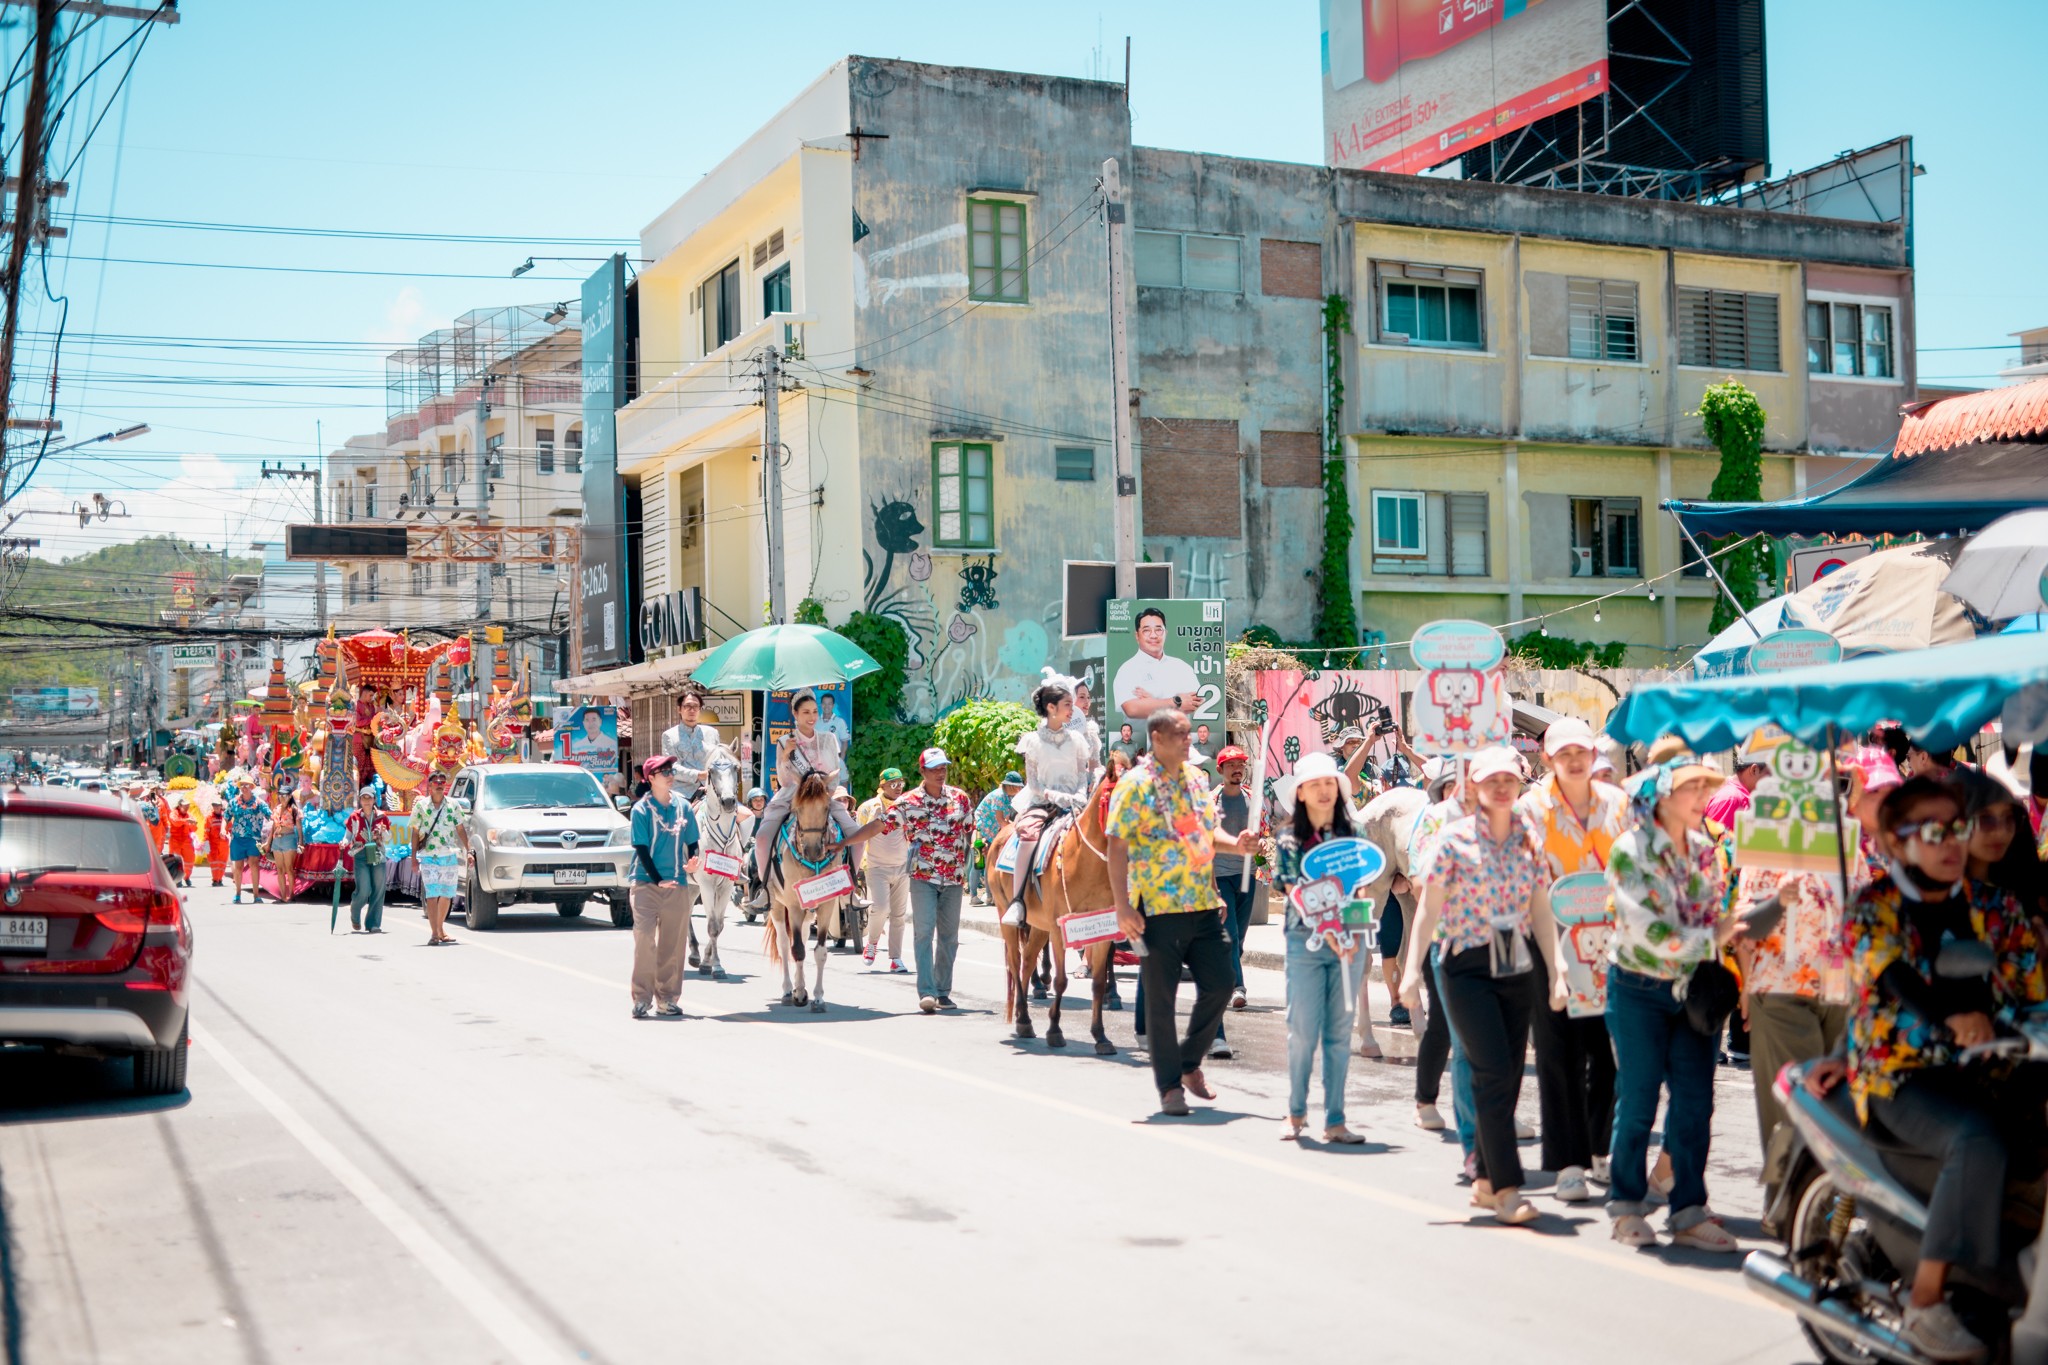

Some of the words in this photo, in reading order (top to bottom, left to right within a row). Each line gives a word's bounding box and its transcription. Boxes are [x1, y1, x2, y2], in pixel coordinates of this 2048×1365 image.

[1375, 95, 1412, 124] EXTREME
[1332, 122, 1361, 164] KA
[639, 587, 701, 651] GOINN
[1177, 626, 1222, 637] นายกฯ
[174, 646, 214, 657] ขายยา
[1188, 639, 1222, 652] เลือก
[174, 658, 216, 666] PHARMACY
[1194, 655, 1222, 675] เป้า
[1193, 683, 1222, 720] 2
[560, 731, 572, 759] 1
[9, 920, 44, 935] 8443
[1069, 924, 1095, 934] Market
[1097, 919, 1118, 929] Villa
